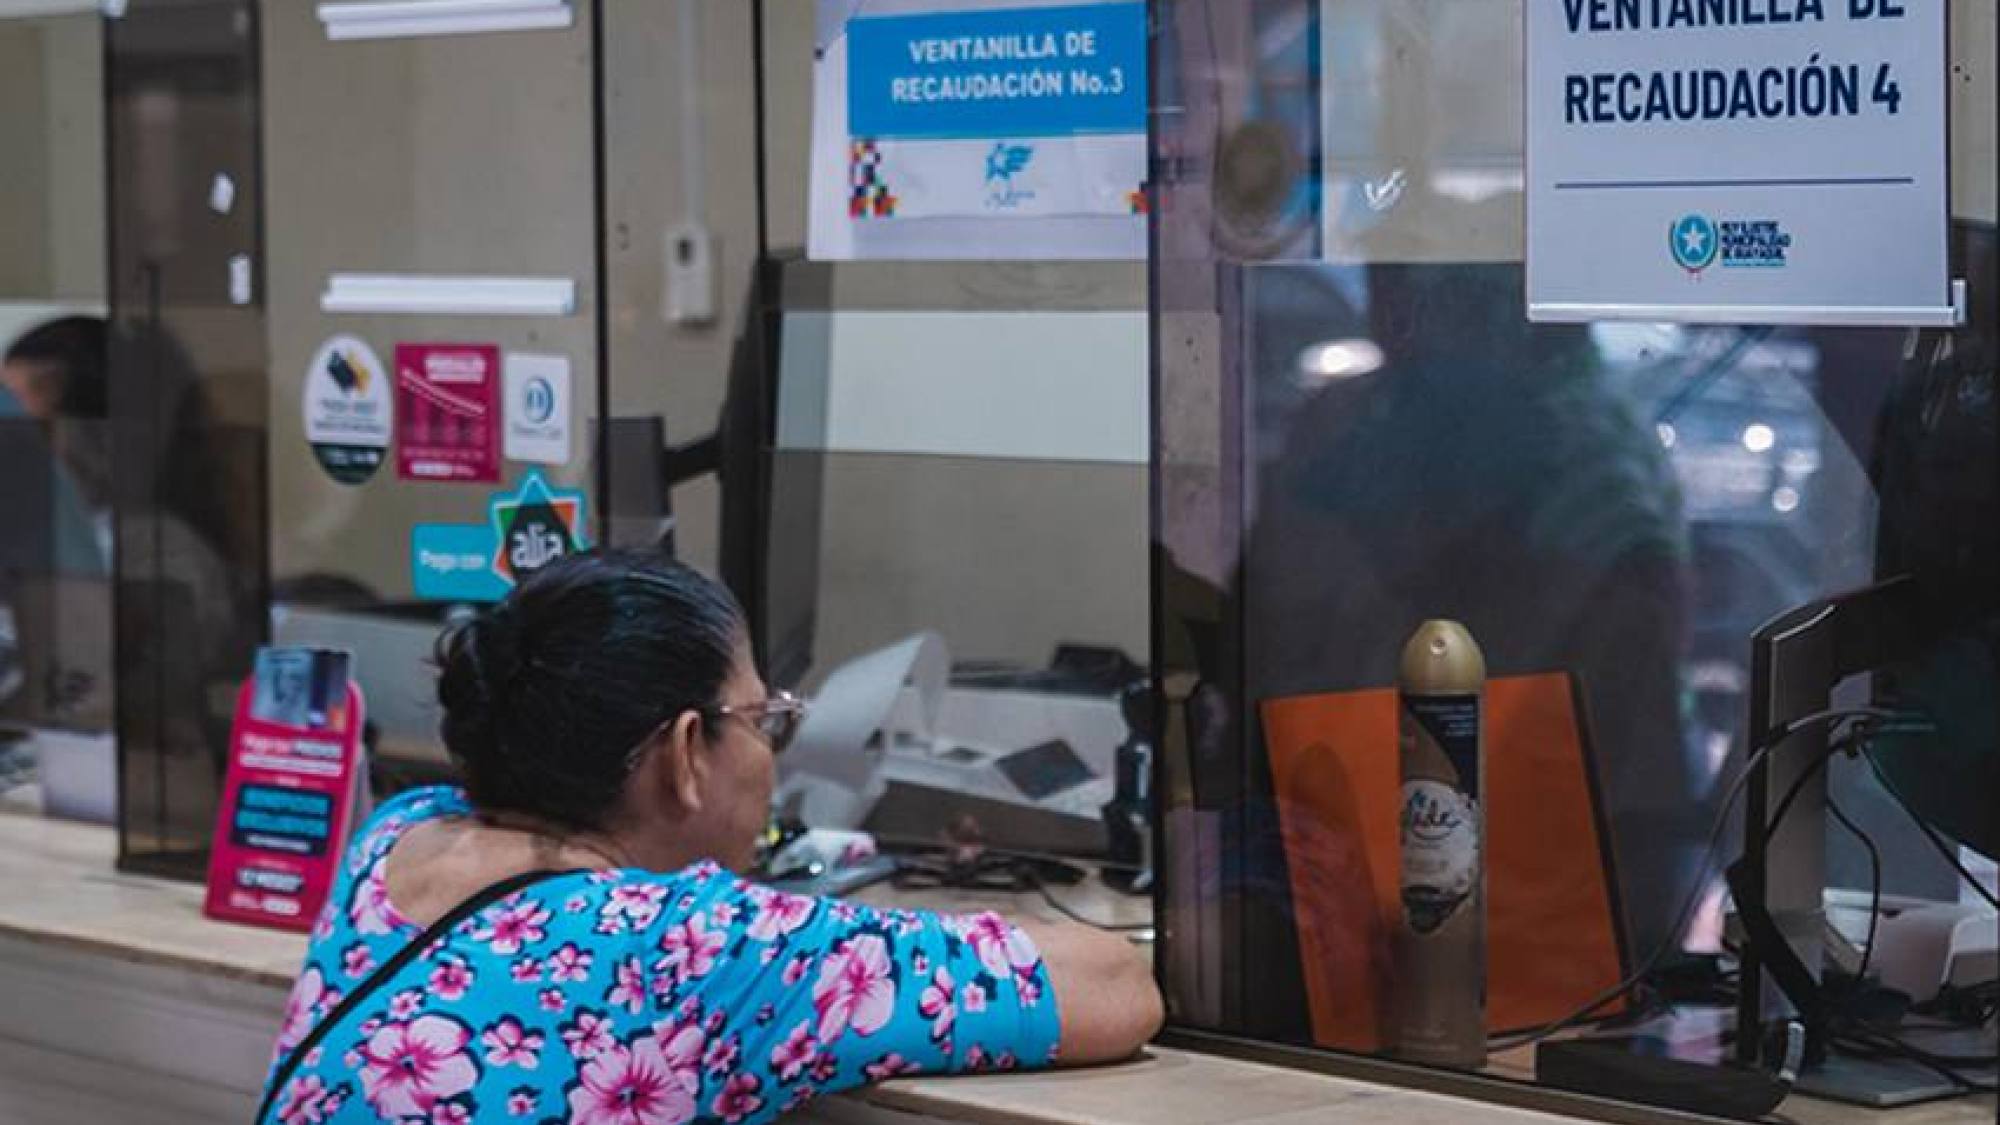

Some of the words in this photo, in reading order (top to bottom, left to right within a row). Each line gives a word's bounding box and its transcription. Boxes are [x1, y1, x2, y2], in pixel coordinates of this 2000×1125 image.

[909, 33, 1058, 63] VENTANILLA
[1065, 30, 1096, 57] DE
[892, 68, 1062, 103] RECAUDACIÓN
[1071, 67, 1123, 96] No.3
[1565, 53, 1859, 123] RECAUDACIÓN
[1872, 63, 1902, 115] 4
